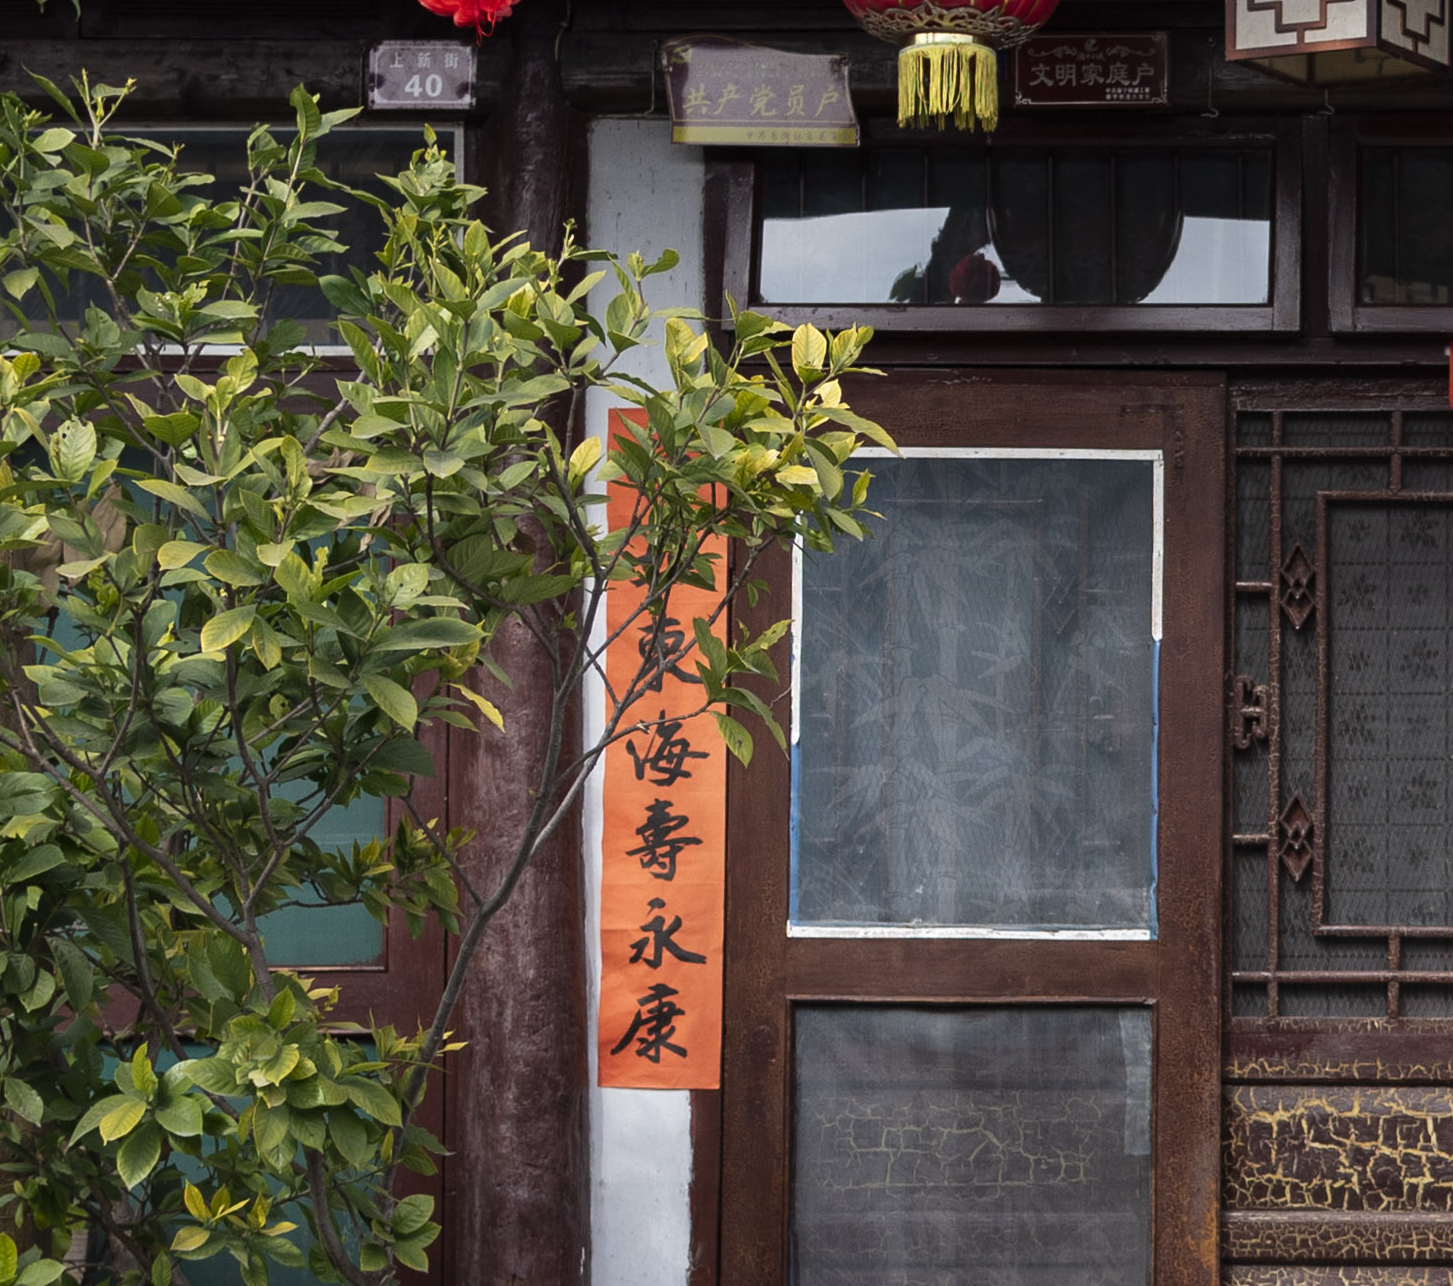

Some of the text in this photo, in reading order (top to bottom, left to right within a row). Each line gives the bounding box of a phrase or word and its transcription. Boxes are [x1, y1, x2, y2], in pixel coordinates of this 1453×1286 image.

[389, 52, 459, 69] 上新街
[404, 74, 443, 98] 40
[1029, 62, 1155, 87] 文明家庭户
[682, 82, 840, 117] 共产党员户
[610, 435, 710, 1064] 東海壽永康
